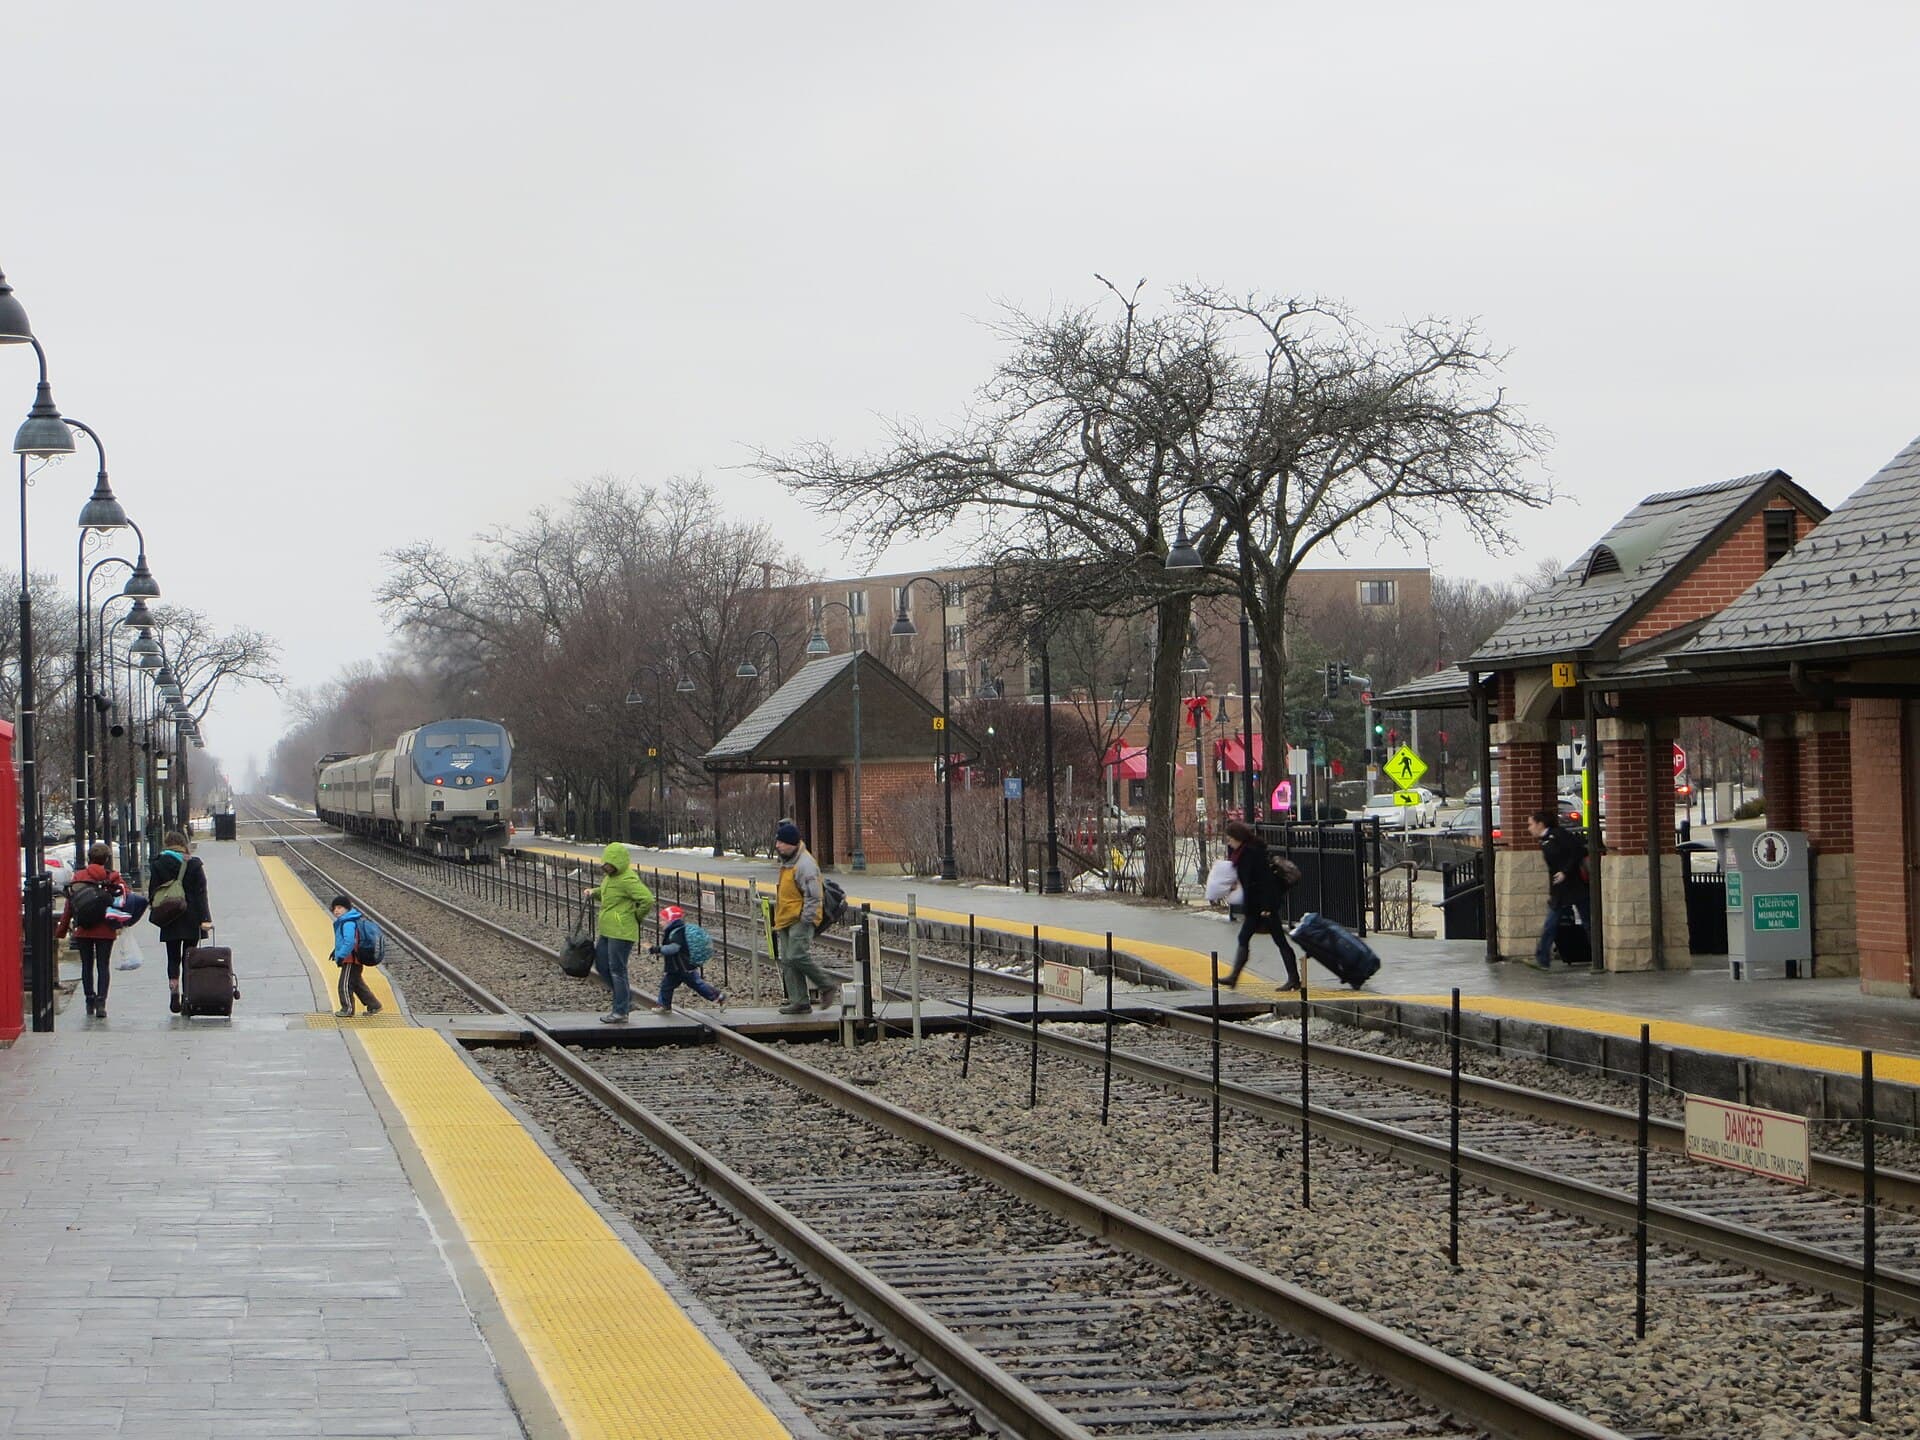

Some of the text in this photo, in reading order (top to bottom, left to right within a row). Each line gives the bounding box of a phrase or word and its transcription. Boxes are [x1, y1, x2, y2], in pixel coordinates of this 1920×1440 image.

[1559, 667, 1568, 682] 4
[1758, 897, 1796, 908] Glenview
[1758, 910, 1795, 919] MUNICIPAL
[1768, 919, 1785, 927] MAIL
[1724, 1111, 1763, 1148] DANGER
[1688, 1135, 1804, 1177] STAY BEHIND YELLOW LINE UNTIL TRAIN STOPS
